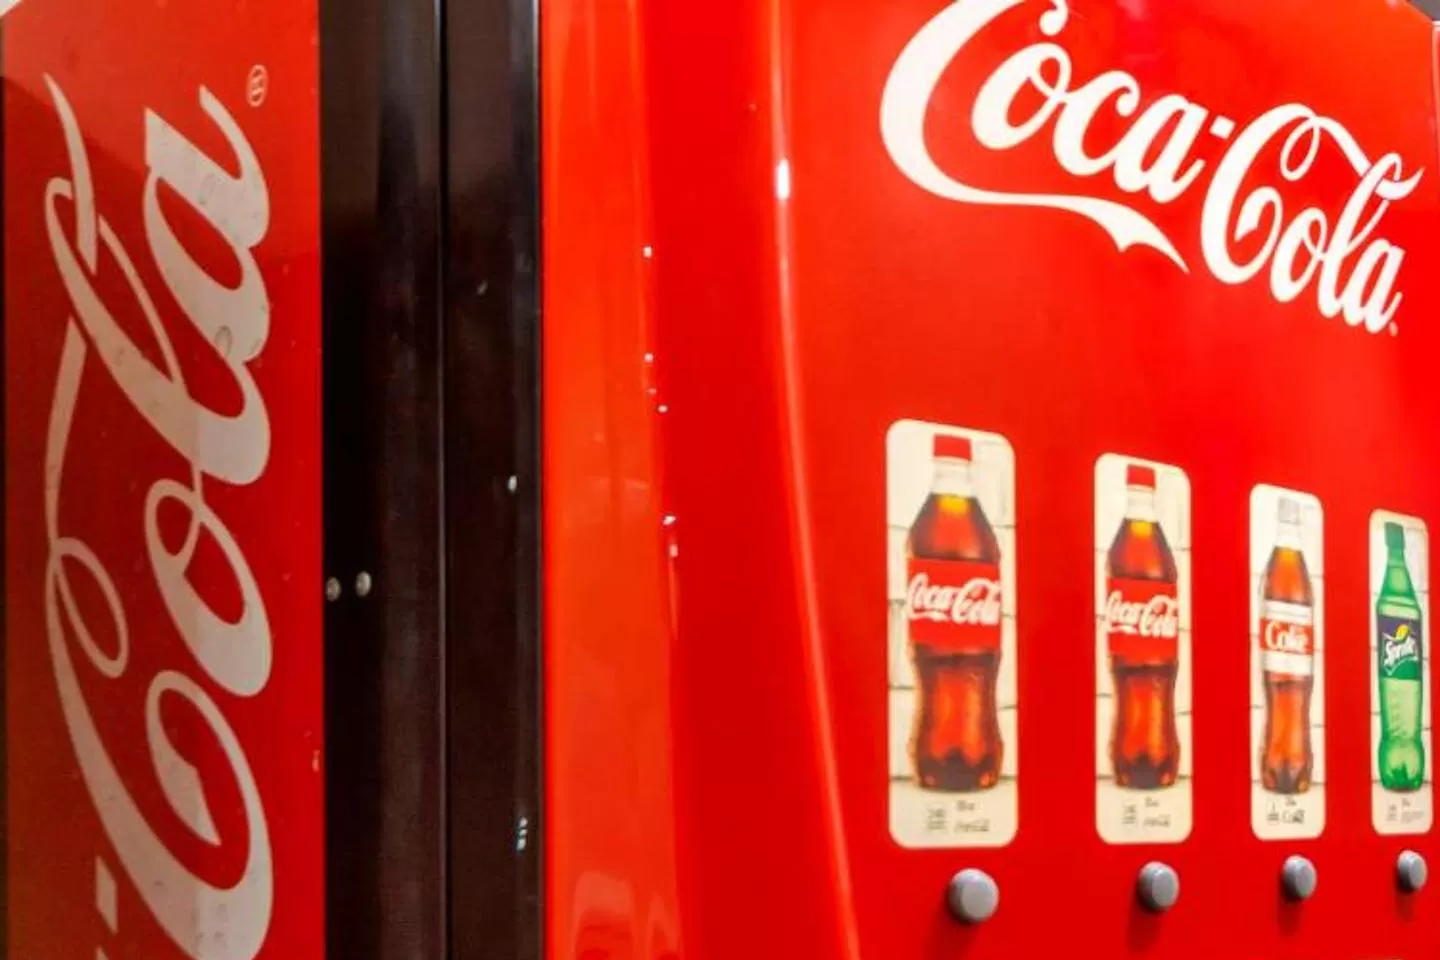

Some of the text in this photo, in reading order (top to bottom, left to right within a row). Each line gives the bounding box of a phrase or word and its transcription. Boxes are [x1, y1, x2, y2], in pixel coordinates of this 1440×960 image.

[880, 0, 1423, 334] Coca-Cola
[909, 572, 1001, 625] Coca-Cola
[1383, 635, 1417, 668] Sprite
